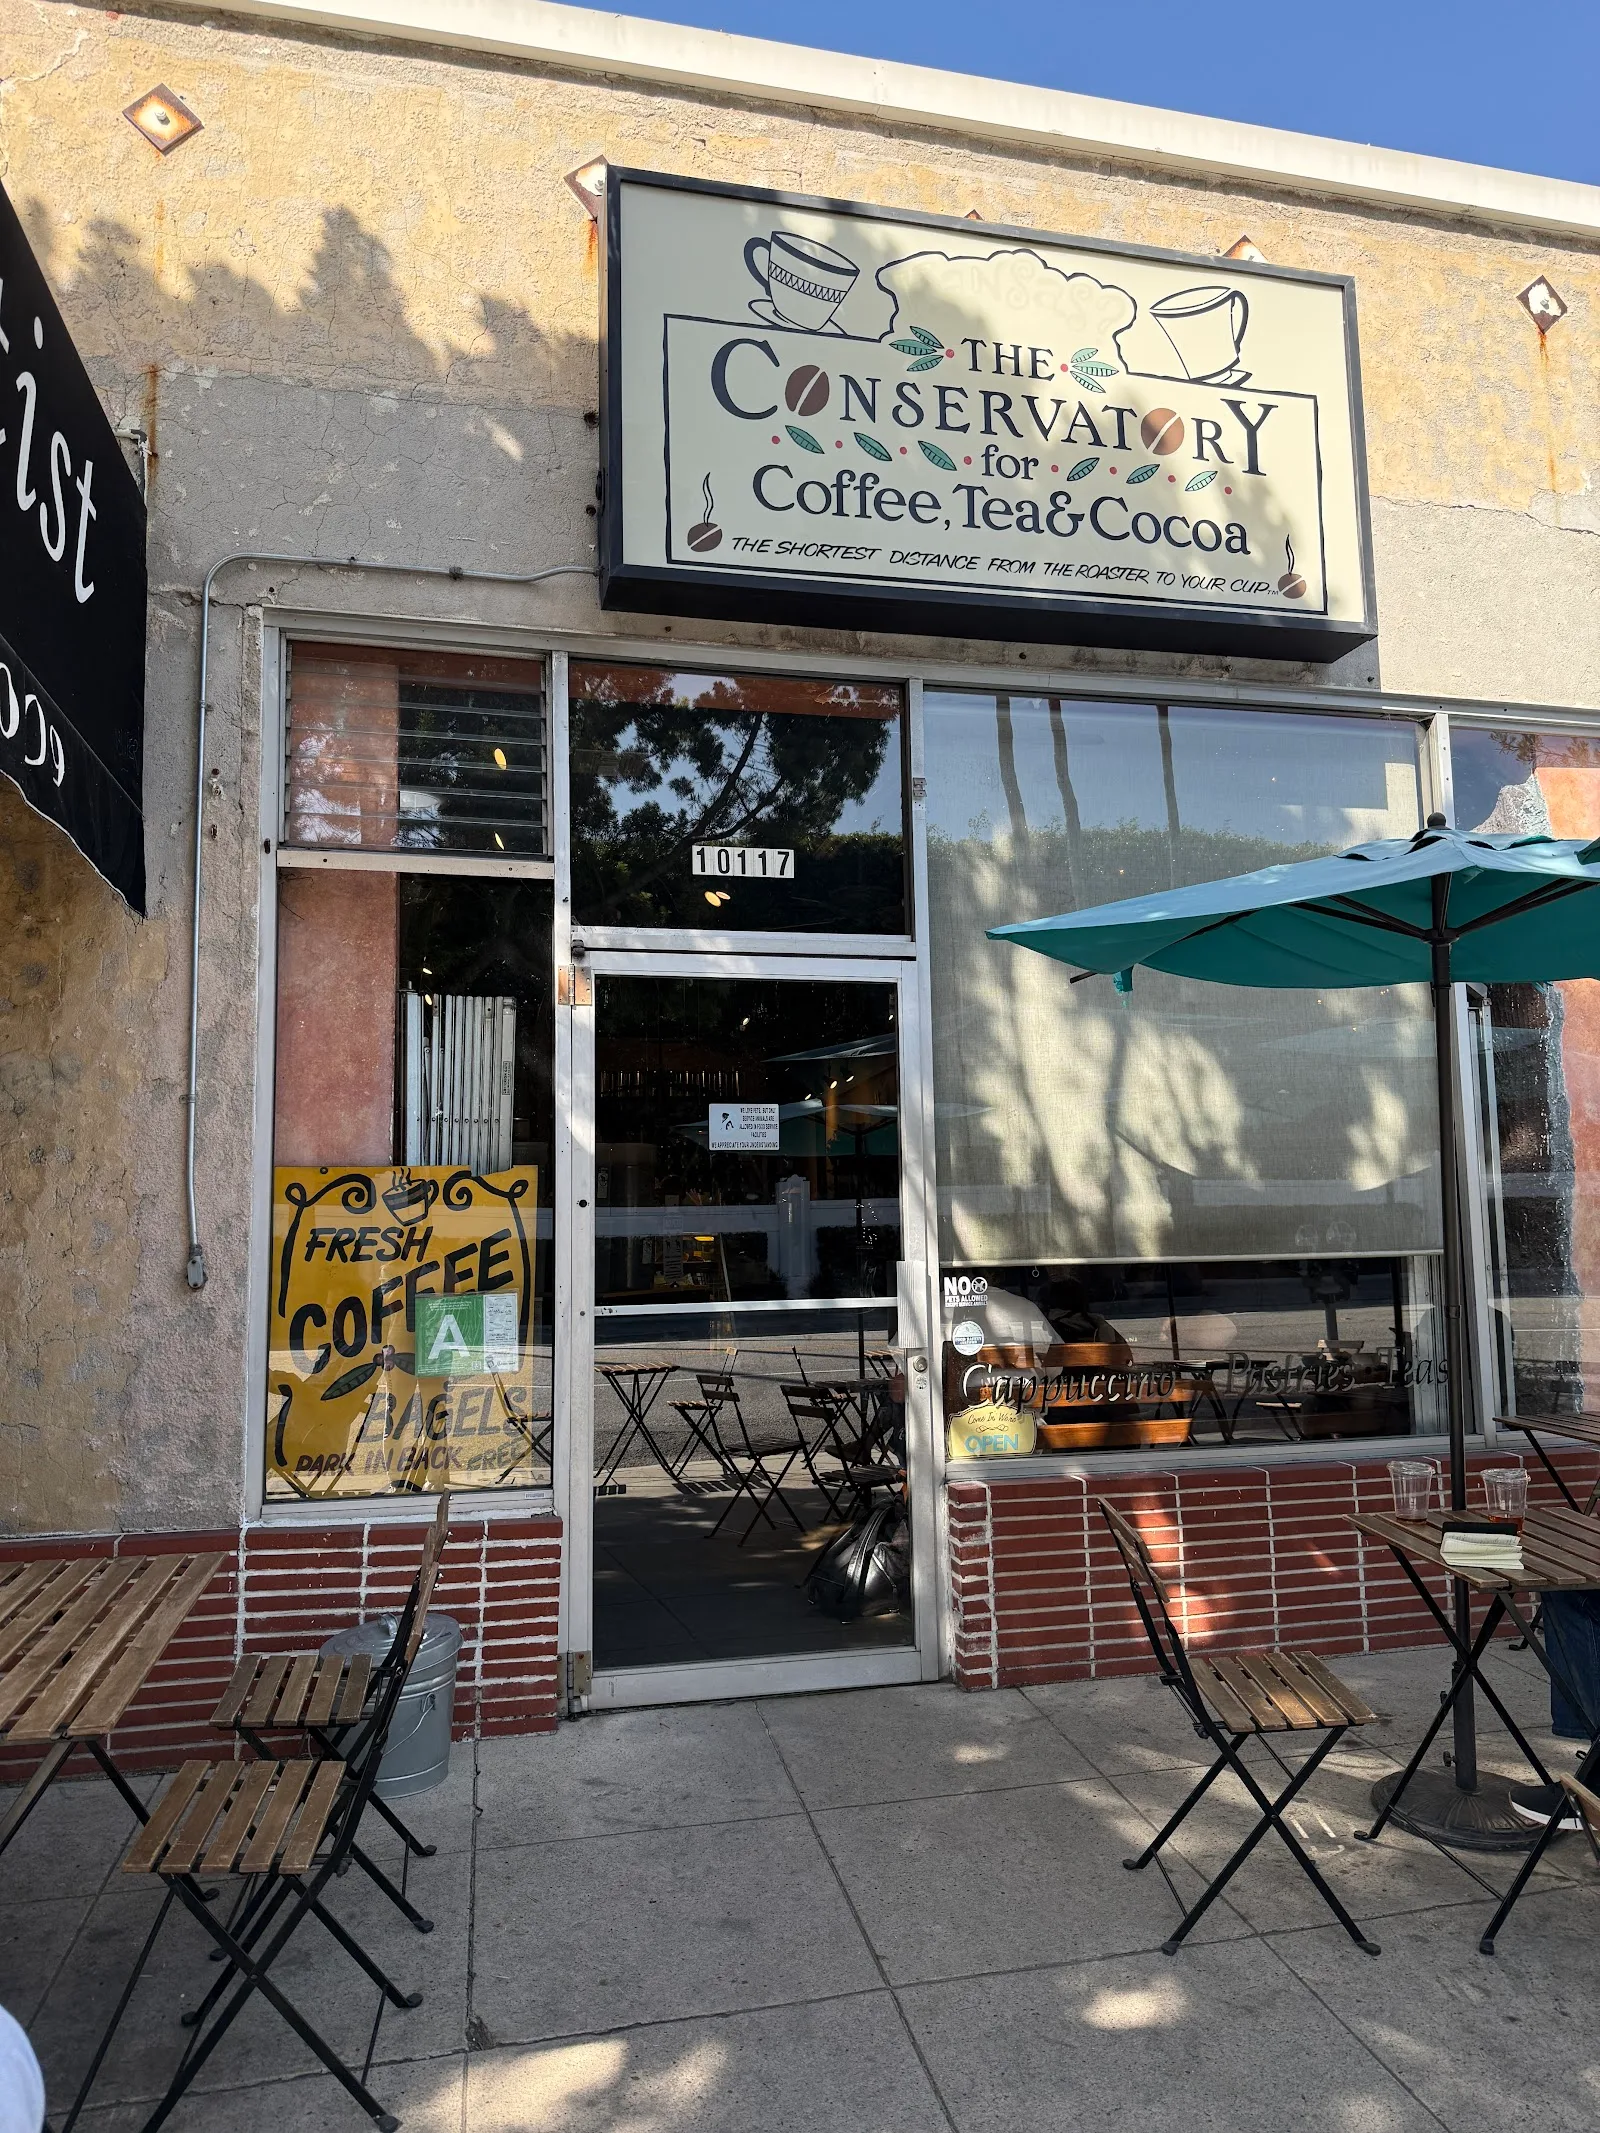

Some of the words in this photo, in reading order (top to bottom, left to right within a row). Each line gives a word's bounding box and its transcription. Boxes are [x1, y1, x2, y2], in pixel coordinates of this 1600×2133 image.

[961, 337, 1055, 382] THE
[711, 338, 1279, 477] CONSERVATORY
[0, 276, 97, 604] ist
[981, 444, 1039, 481] for
[753, 464, 951, 530] Coffee,
[731, 537, 774, 553] THE
[775, 541, 882, 561] SHORTEST
[889, 550, 981, 570] DISTANCE
[988, 557, 1037, 575] FROM
[1043, 562, 1074, 578] THE
[1075, 565, 1150, 585] ROASTER
[1156, 571, 1176, 586] TO
[1181, 574, 1227, 593] YOUR
[696, 847, 790, 876] 10117
[304, 1226, 434, 1263] FRESH
[289, 1228, 515, 1374] COFFEE
[943, 1276, 971, 1296] NO
[945, 1295, 960, 1303] PETS
[961, 1294, 988, 1303] ALLOWED
[428, 1314, 470, 1360] A
[360, 1386, 528, 1442] BAGELS
[961, 1362, 1176, 1423] Cappuccino
[295, 1452, 355, 1476] PARK
[364, 1447, 394, 1474] IN
[397, 1446, 463, 1472] BACK
[965, 1433, 1018, 1452] OPEN
